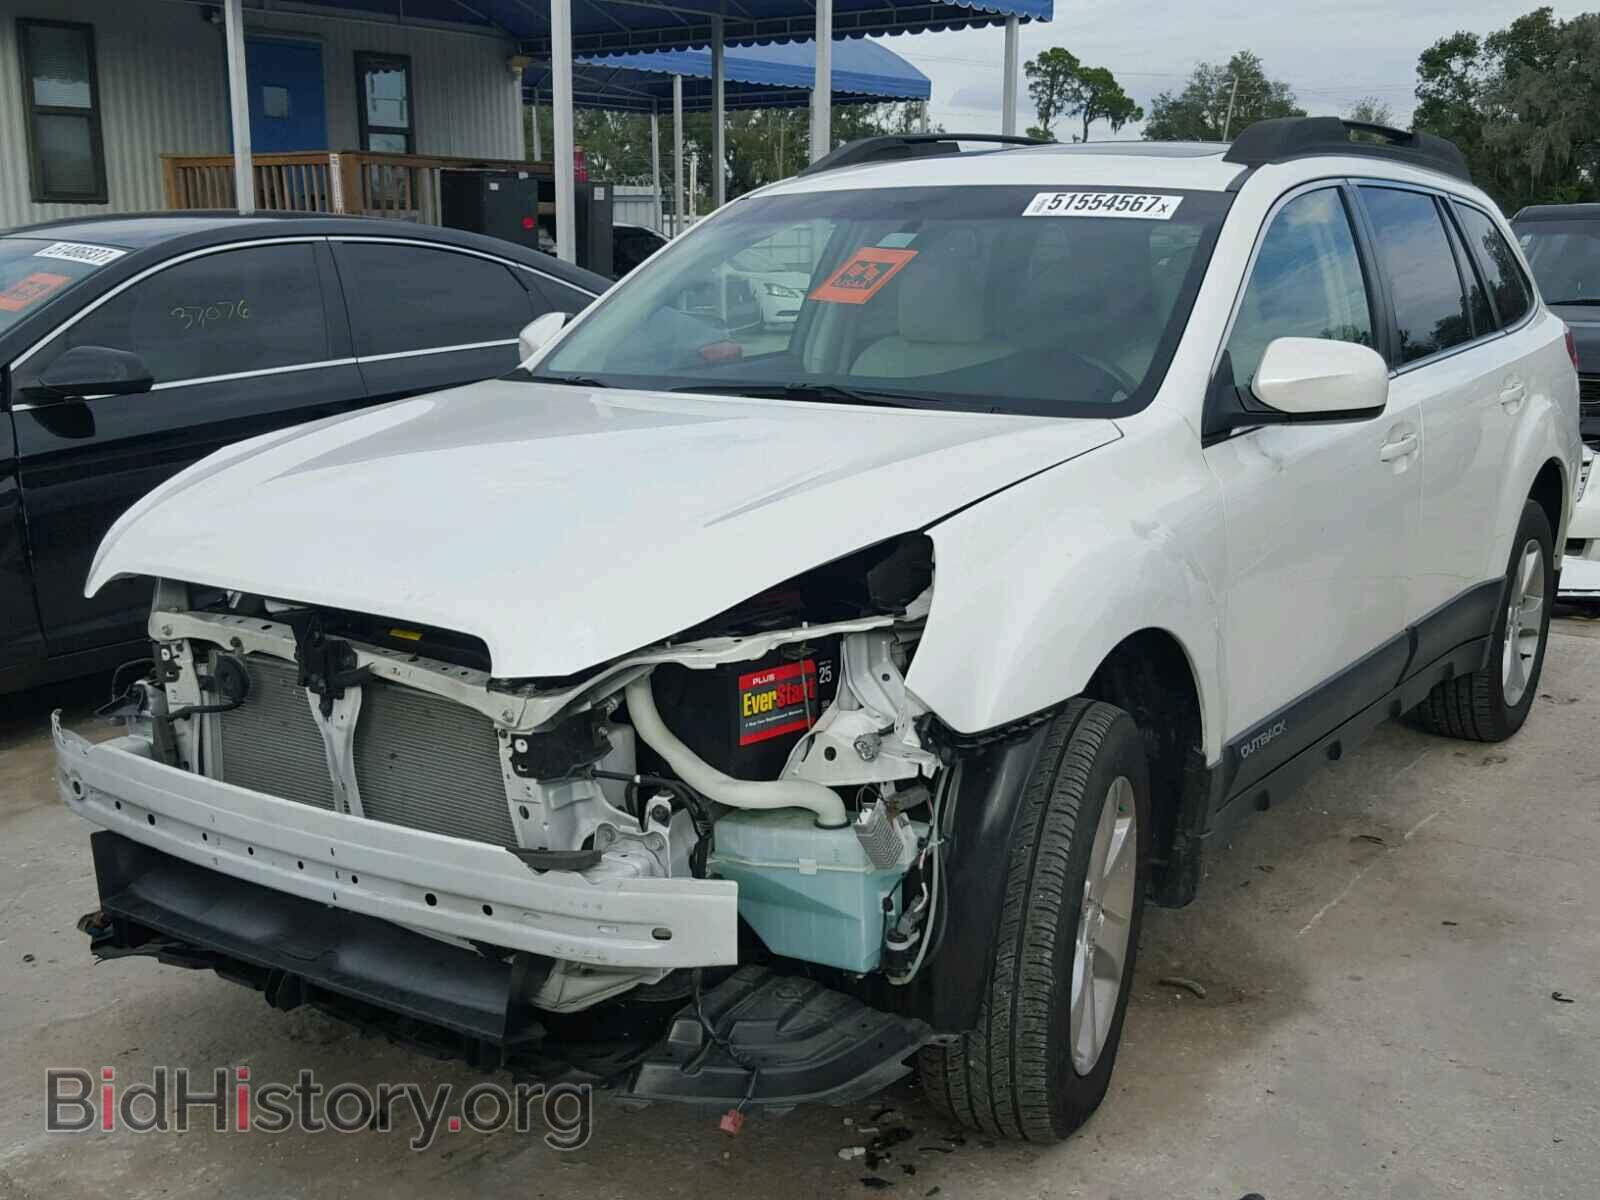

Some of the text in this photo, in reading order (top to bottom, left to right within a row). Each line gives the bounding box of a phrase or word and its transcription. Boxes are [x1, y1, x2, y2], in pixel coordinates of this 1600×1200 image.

[752, 673, 776, 686] PLUS
[818, 665, 833, 684] 25
[1240, 719, 1288, 759] OUTBACK
